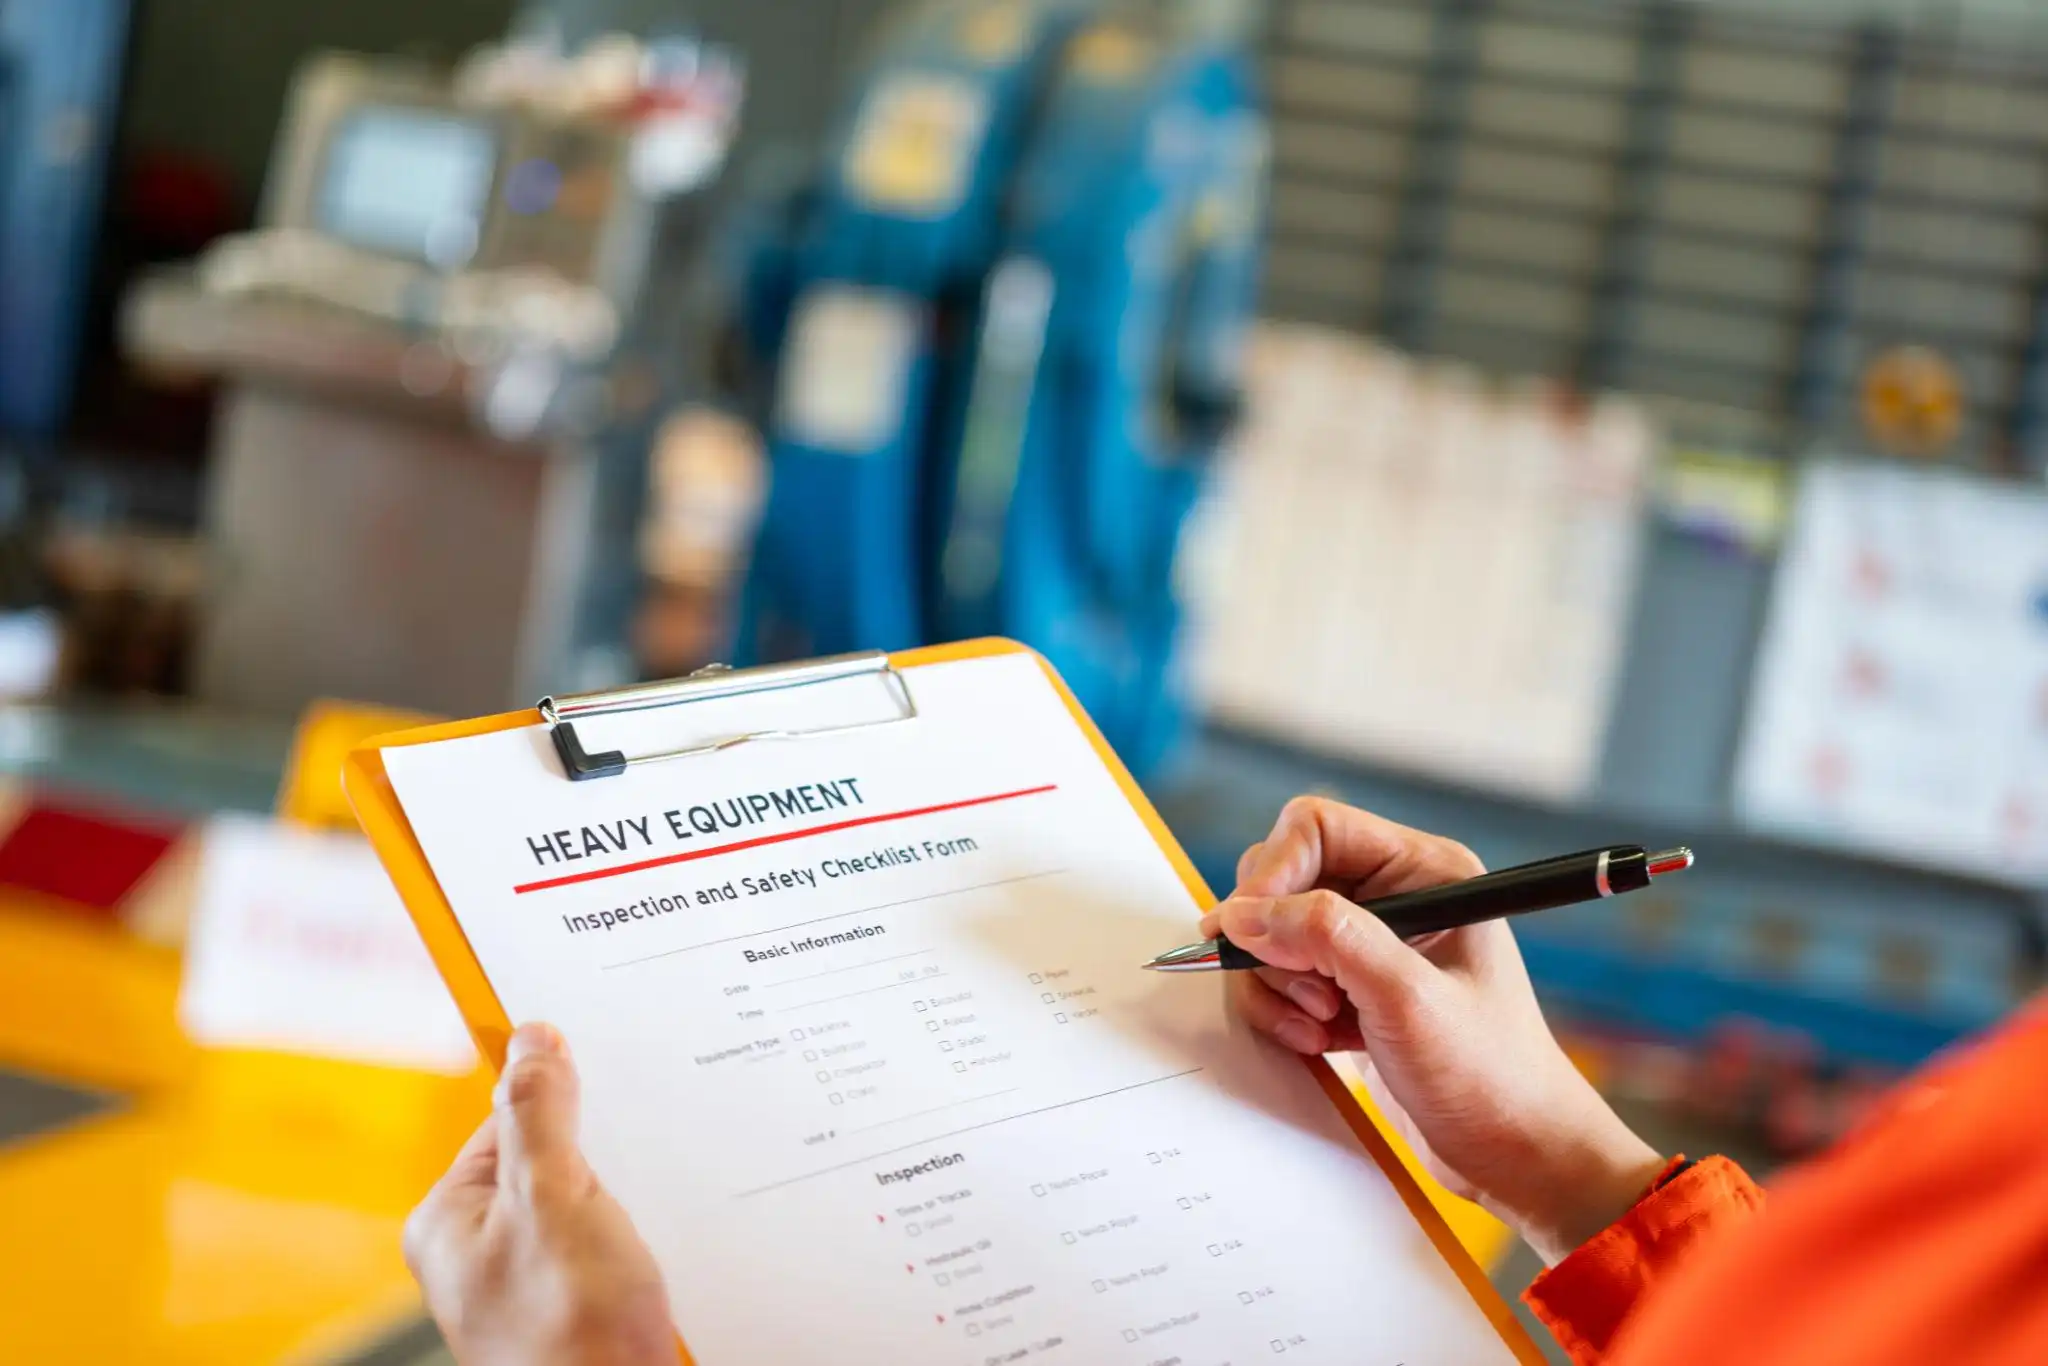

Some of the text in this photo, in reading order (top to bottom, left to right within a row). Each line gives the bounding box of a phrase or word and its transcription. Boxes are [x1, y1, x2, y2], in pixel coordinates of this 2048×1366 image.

[526, 777, 865, 866] HEAVY EQUIPMENT
[562, 834, 979, 935] Inspection and Safety Checklist Form
[743, 922, 885, 964] Basic Information
[723, 984, 750, 996] Date
[737, 1009, 764, 1020] Time
[694, 1044, 752, 1065] Equipment
[755, 1037, 780, 1051] Type
[876, 1151, 965, 1186] Inspection
